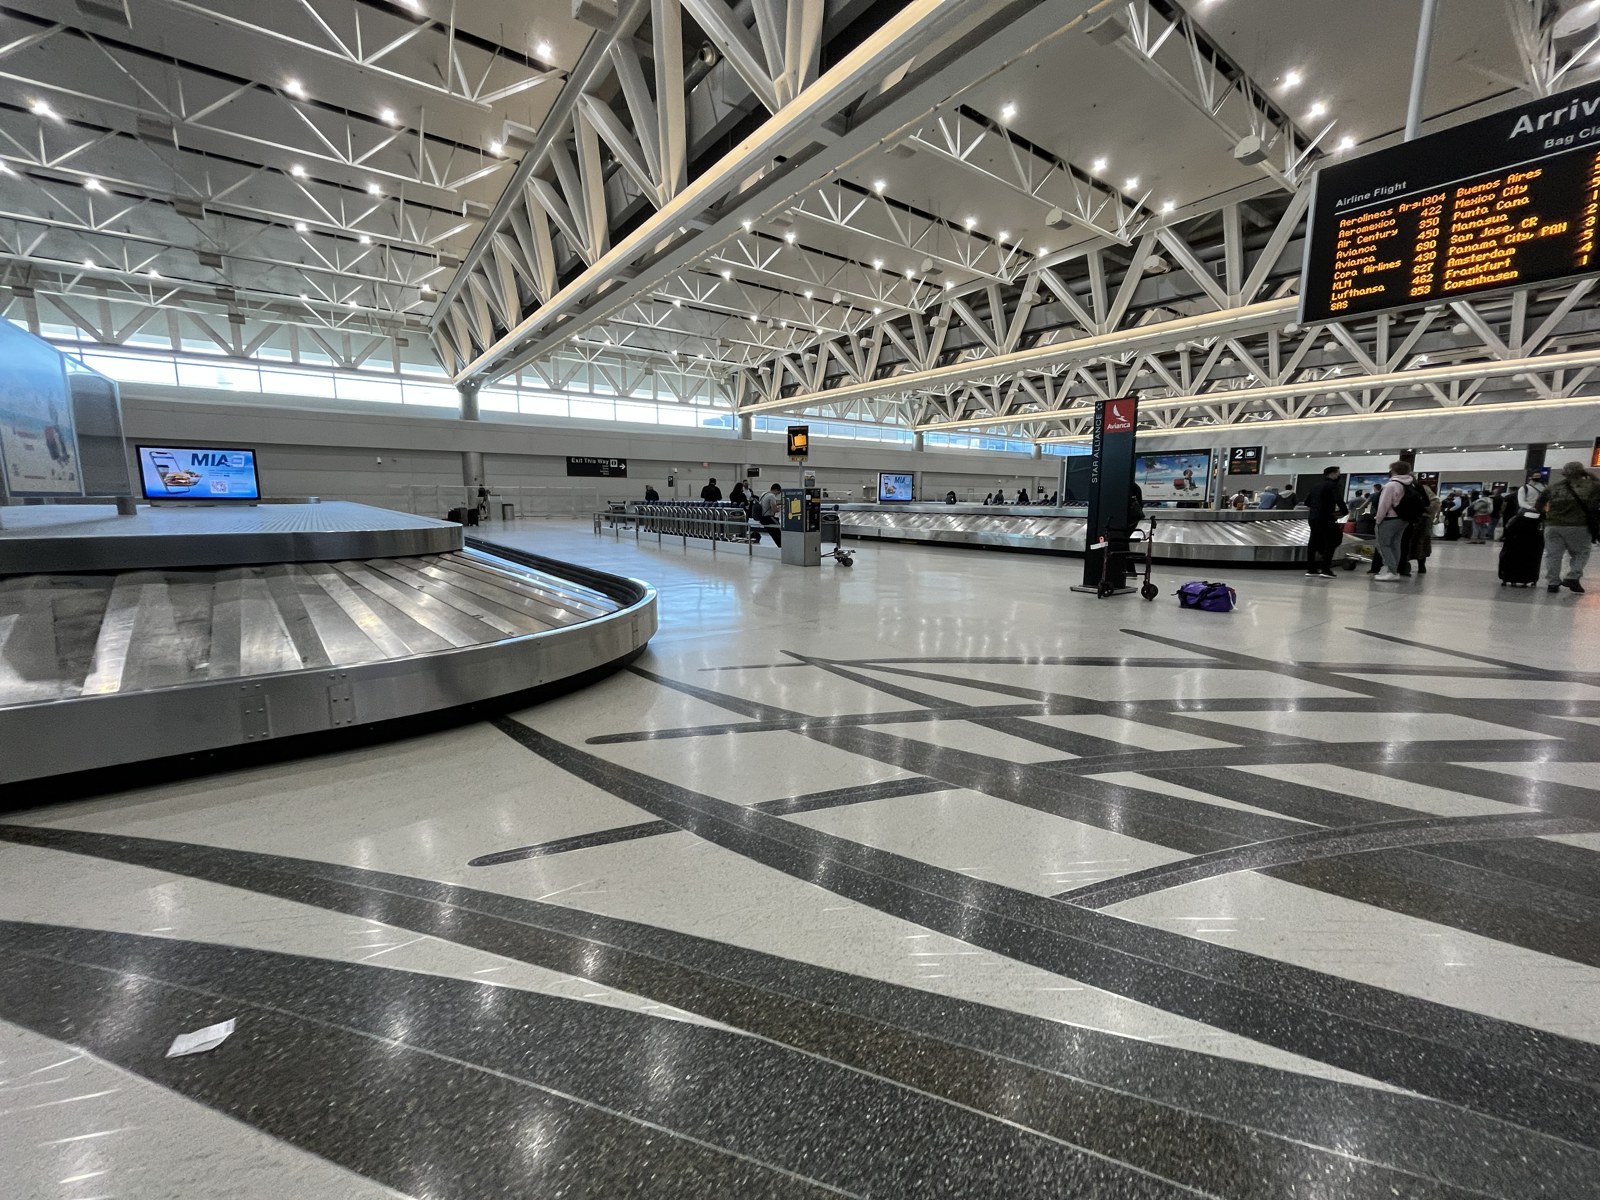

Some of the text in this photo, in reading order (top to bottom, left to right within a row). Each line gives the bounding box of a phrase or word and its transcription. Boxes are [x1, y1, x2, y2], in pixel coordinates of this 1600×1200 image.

[1508, 97, 1600, 139] Arriv
[1544, 135, 1574, 149] Bag
[1335, 181, 1407, 207] Airline Flight
[1338, 219, 1396, 239] Aeromexico
[1420, 204, 1443, 217] 422
[1454, 193, 1496, 209] Mexico
[1502, 185, 1528, 197] City
[1339, 208, 1394, 228] Aerolineas
[1456, 179, 1501, 197] Buenos
[1507, 168, 1543, 184] Aires
[1335, 203, 1598, 270] Avianca 690 San Jose, CR 2
[1336, 245, 1377, 259] Avianca
[1417, 228, 1440, 240] 450
[1592, 189, 1599, 200] 1
[1337, 240, 1352, 249] Air
[1356, 228, 1399, 244] Century
[1418, 217, 1440, 229] 350
[1453, 206, 1489, 220] Punta
[1496, 196, 1530, 210] Cana
[1331, 284, 1386, 301] Lufthansa
[1445, 257, 1511, 279] Frankfurt
[1582, 241, 1593, 252] 4
[1332, 279, 1352, 290] KLM
[1412, 262, 1434, 274] 627
[1447, 247, 1516, 267] Amsterdam
[1333, 269, 1358, 280] Copa
[1363, 259, 1402, 274] Airlines
[1414, 251, 1437, 262] 430
[1448, 240, 1498, 256] Panama
[1504, 232, 1535, 244] City,
[1330, 300, 1349, 311] SAS
[1410, 285, 1431, 296] 953
[1093, 414, 1102, 458] ALLIANCE
[1107, 422, 1131, 430] Avianca
[191, 453, 231, 467] MIA
[1234, 448, 1244, 459] 2
[1420, 472, 1427, 480] 3
